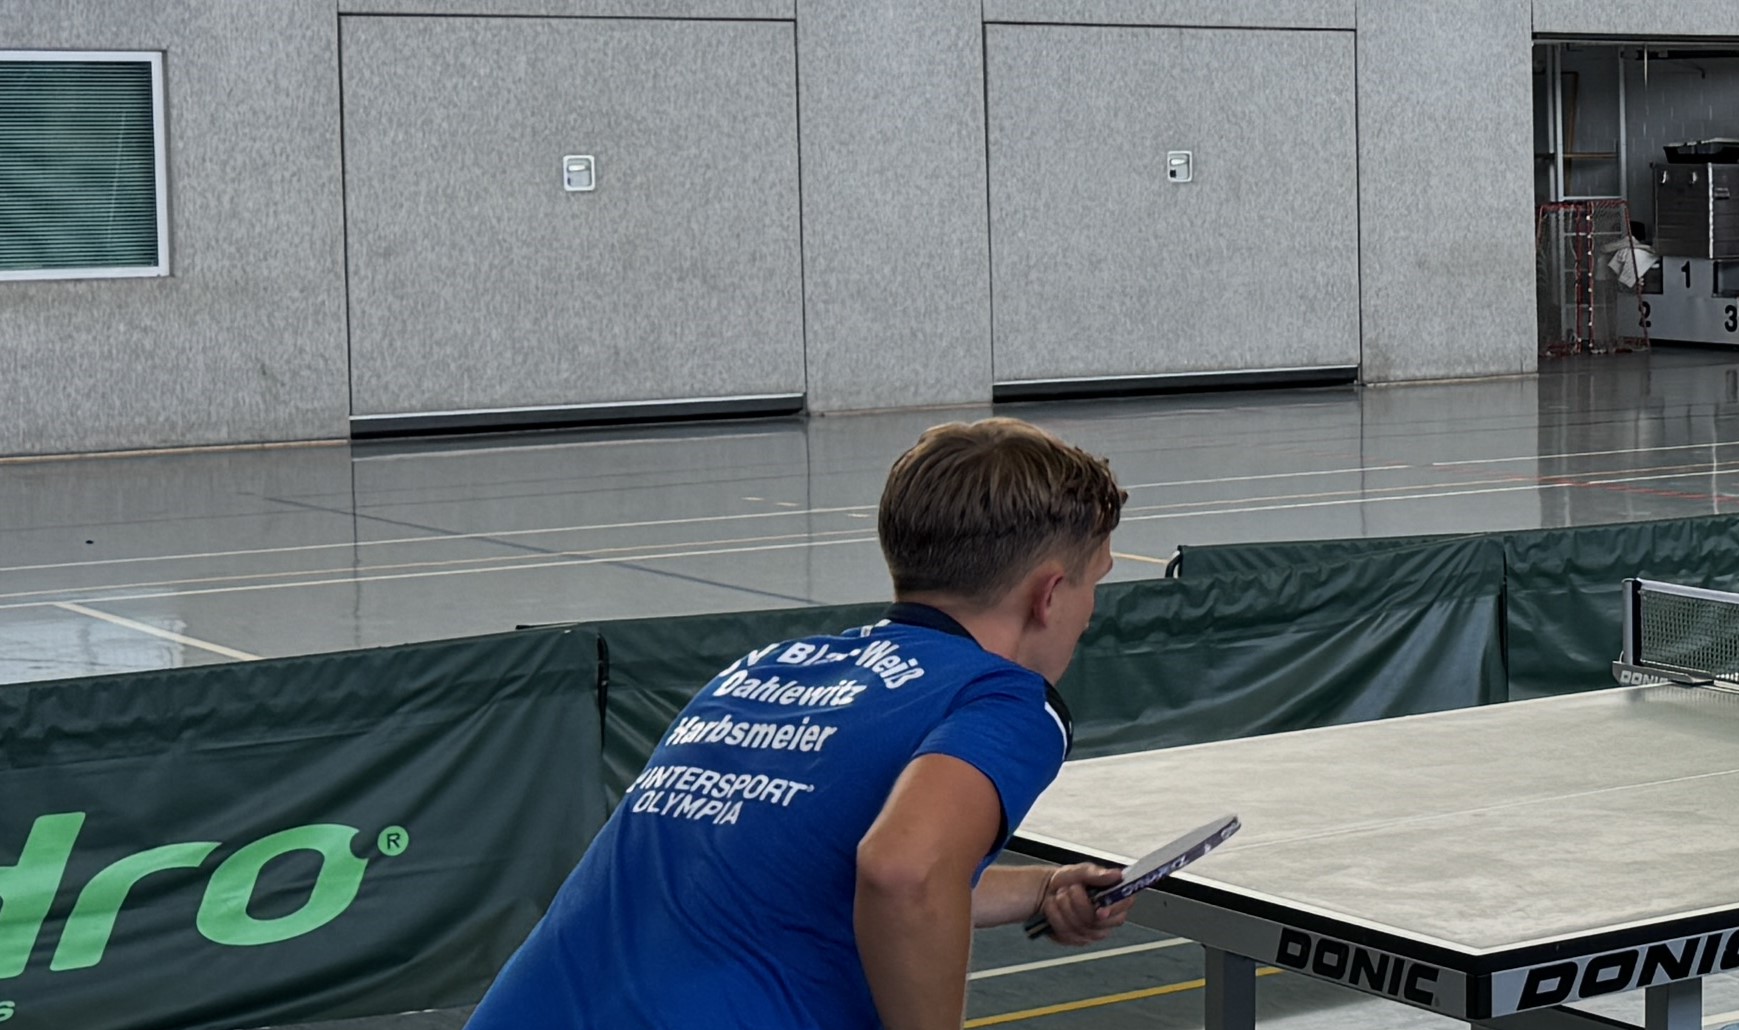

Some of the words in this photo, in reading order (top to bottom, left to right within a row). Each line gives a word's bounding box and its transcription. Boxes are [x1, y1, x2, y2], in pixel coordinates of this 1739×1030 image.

[1681, 260, 1691, 289] 1
[1638, 301, 1652, 328] 2
[1724, 304, 1738, 333] 3
[712, 669, 867, 706] Dahlewitz
[665, 714, 838, 752] Harbsmeier
[639, 765, 807, 806] INTERSPORT
[632, 790, 743, 825] OLYMPIA
[1275, 927, 1440, 1006] DONIC
